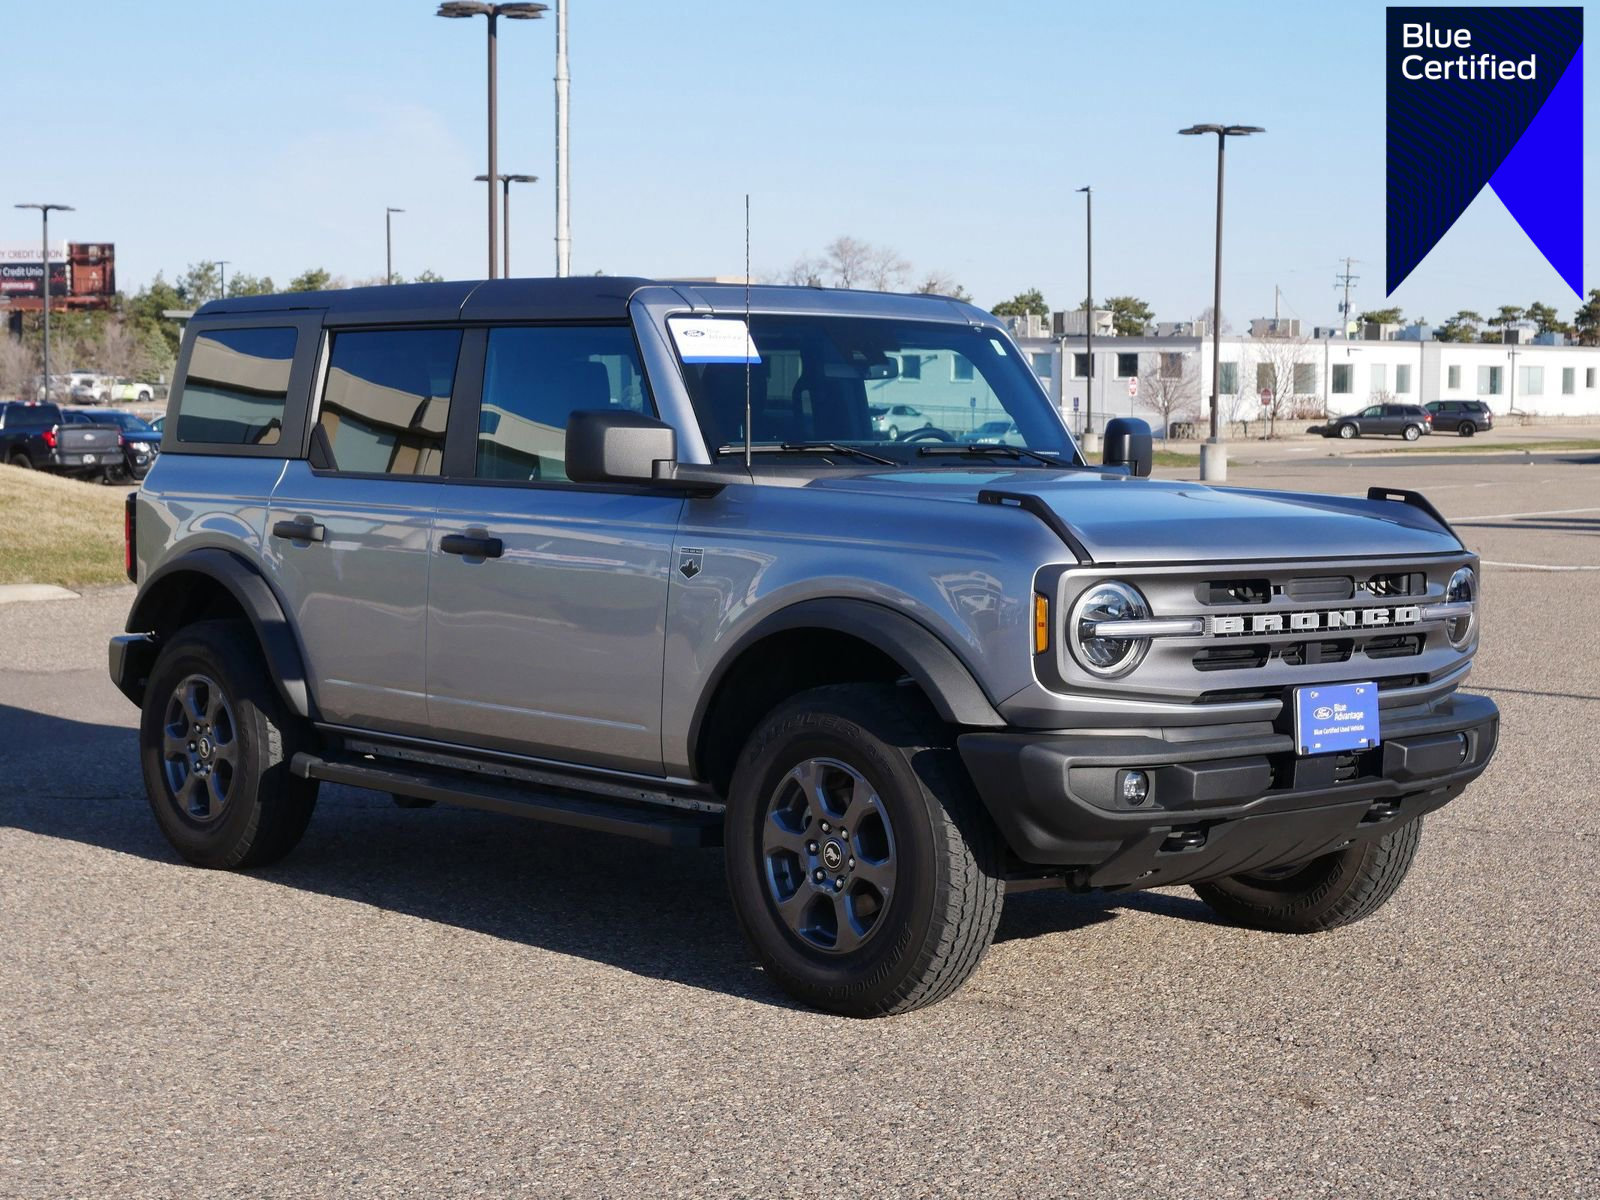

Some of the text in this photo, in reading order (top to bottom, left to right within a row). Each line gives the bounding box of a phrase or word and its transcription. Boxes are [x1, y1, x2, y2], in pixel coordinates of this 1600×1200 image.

[2, 266, 44, 277] Credit Unio
[1213, 606, 1422, 634] BRONCO
[1333, 703, 1347, 712] Blue
[1334, 711, 1364, 721] Advantage
[1323, 726, 1339, 735] Certified
[1340, 725, 1350, 733] Used
[1350, 724, 1365, 732] Vehicle
